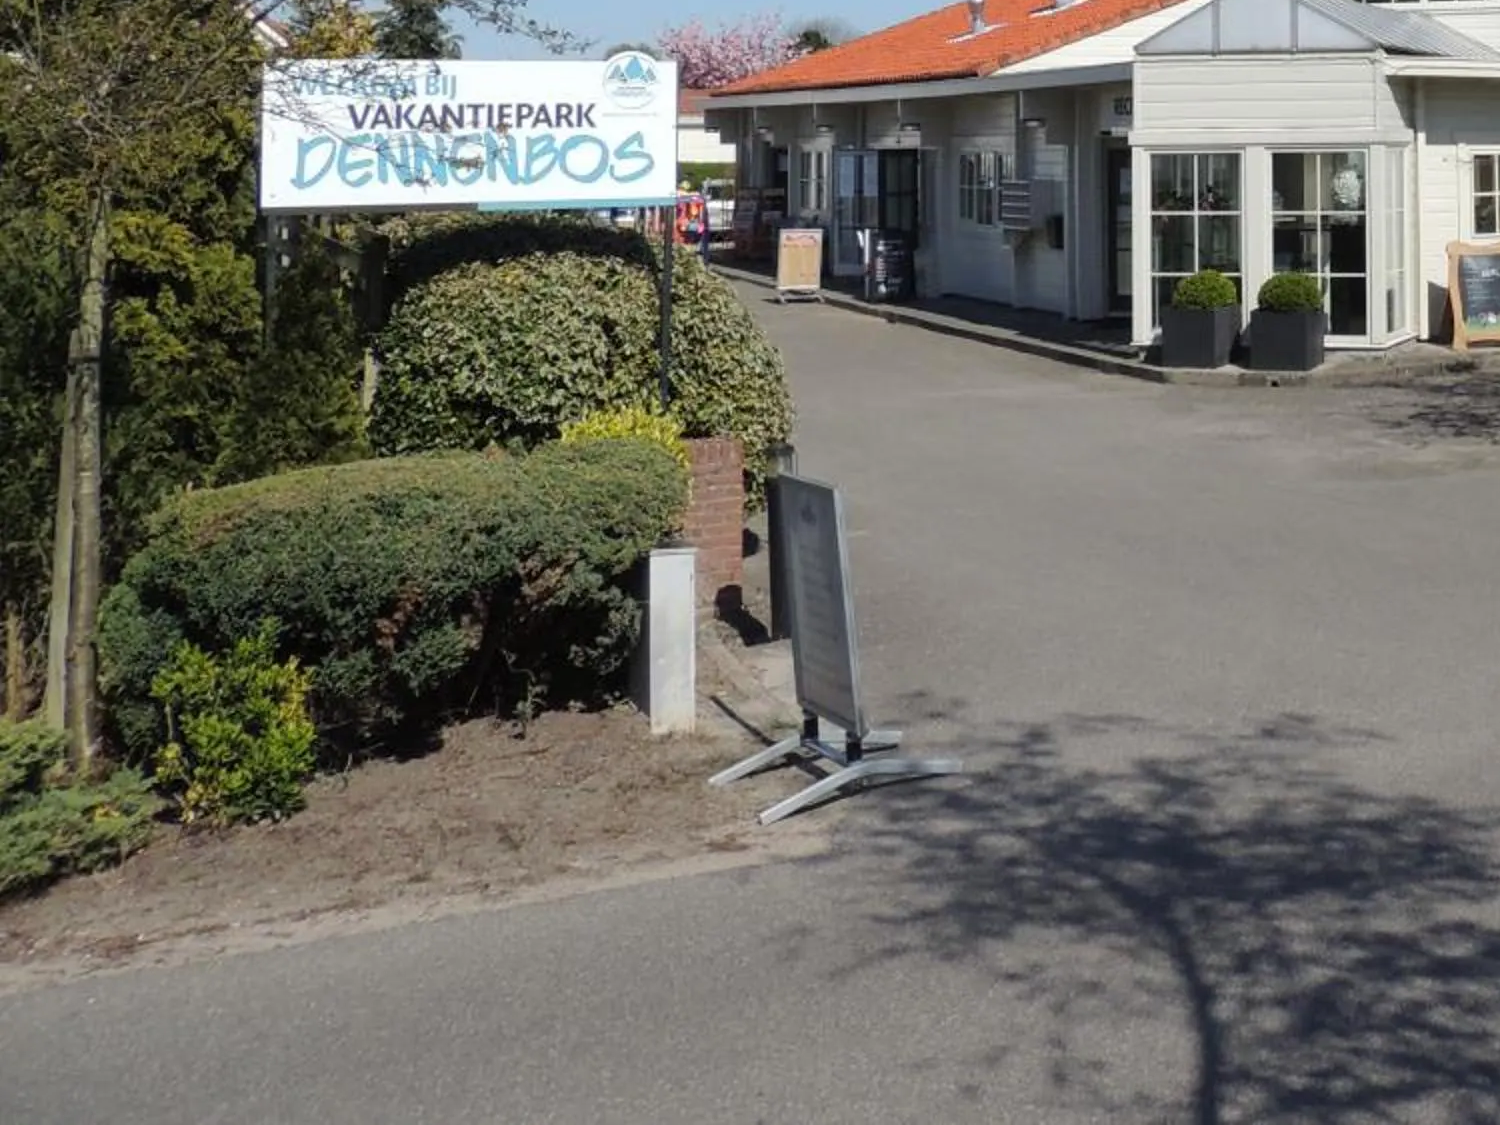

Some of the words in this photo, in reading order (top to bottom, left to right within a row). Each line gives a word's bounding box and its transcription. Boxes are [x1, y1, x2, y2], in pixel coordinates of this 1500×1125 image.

[425, 74, 458, 100] BIJ
[348, 103, 597, 129] VAKANTIEPARK
[290, 130, 655, 189] DENNENBOS
